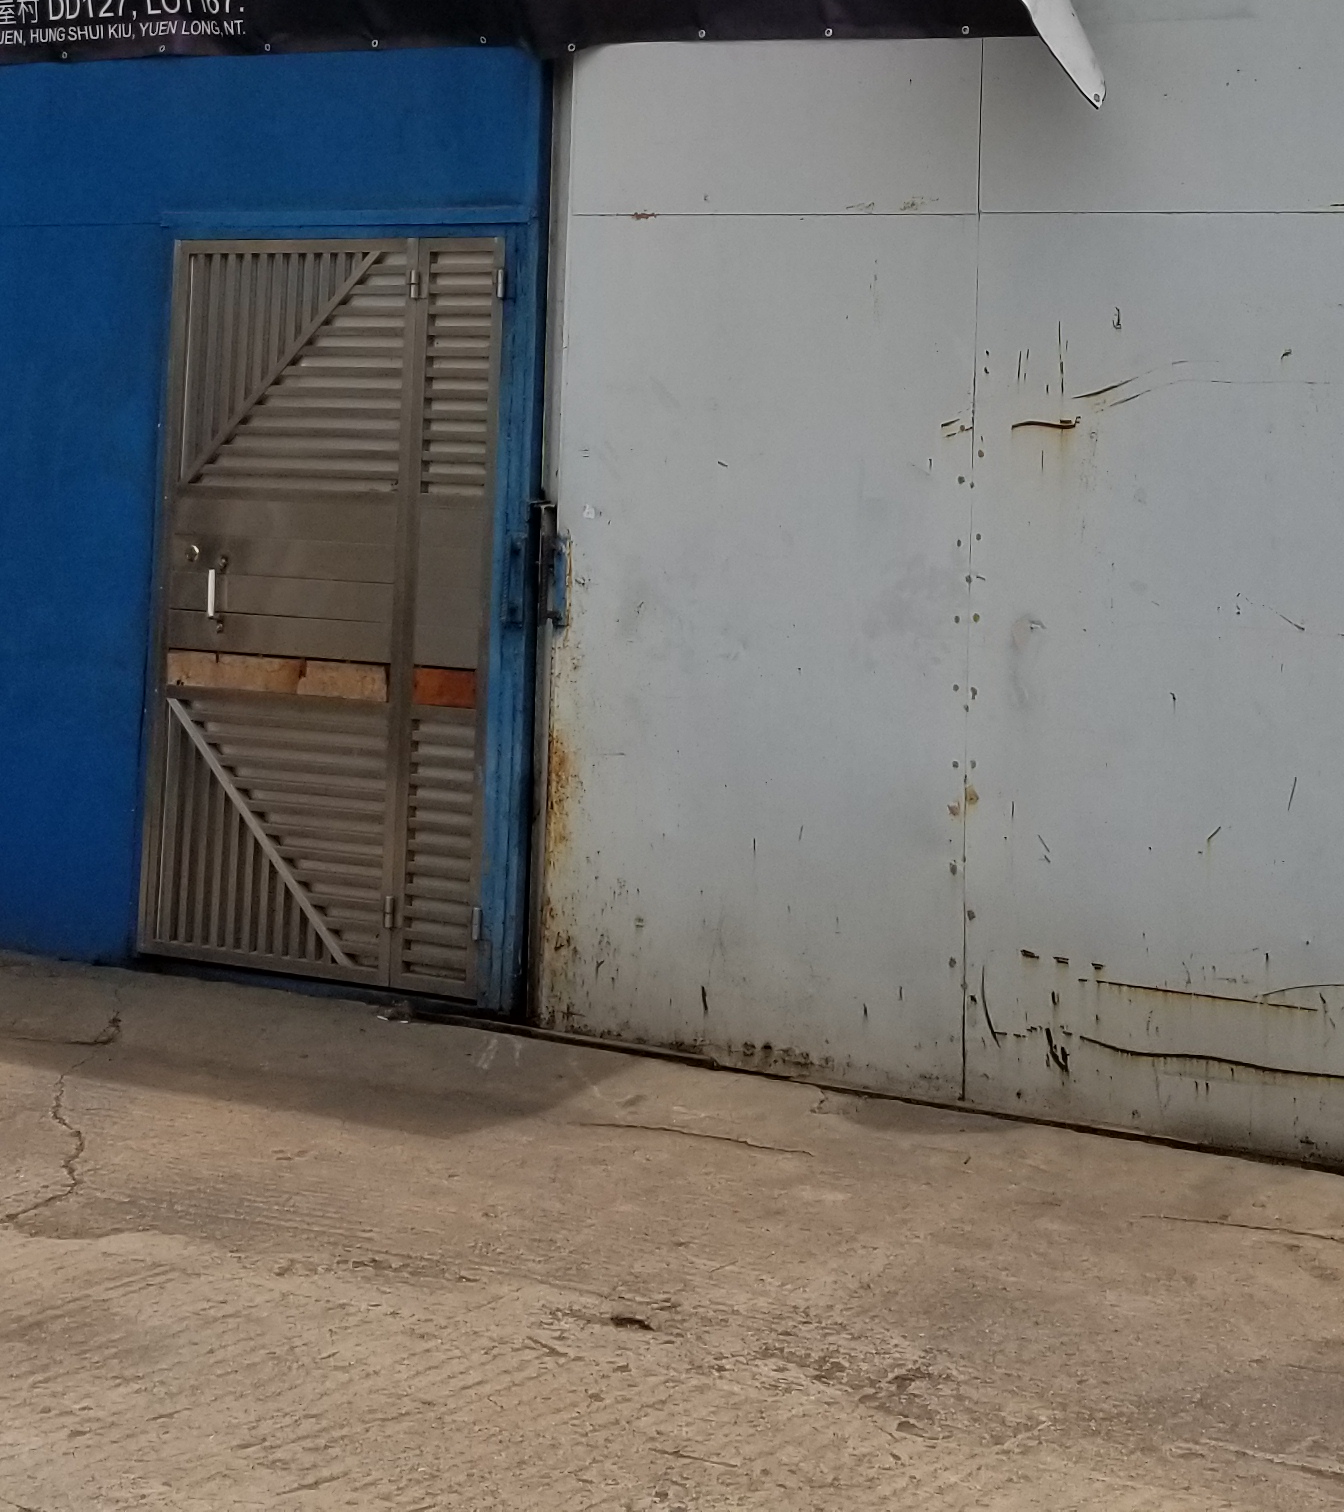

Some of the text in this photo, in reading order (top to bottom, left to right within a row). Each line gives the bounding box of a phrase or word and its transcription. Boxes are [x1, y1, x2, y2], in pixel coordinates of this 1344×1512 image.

[30, 27, 66, 44] HUNG
[68, 25, 104, 41] SHUI
[108, 22, 135, 39] KIU,
[140, 20, 178, 36] YUEN
